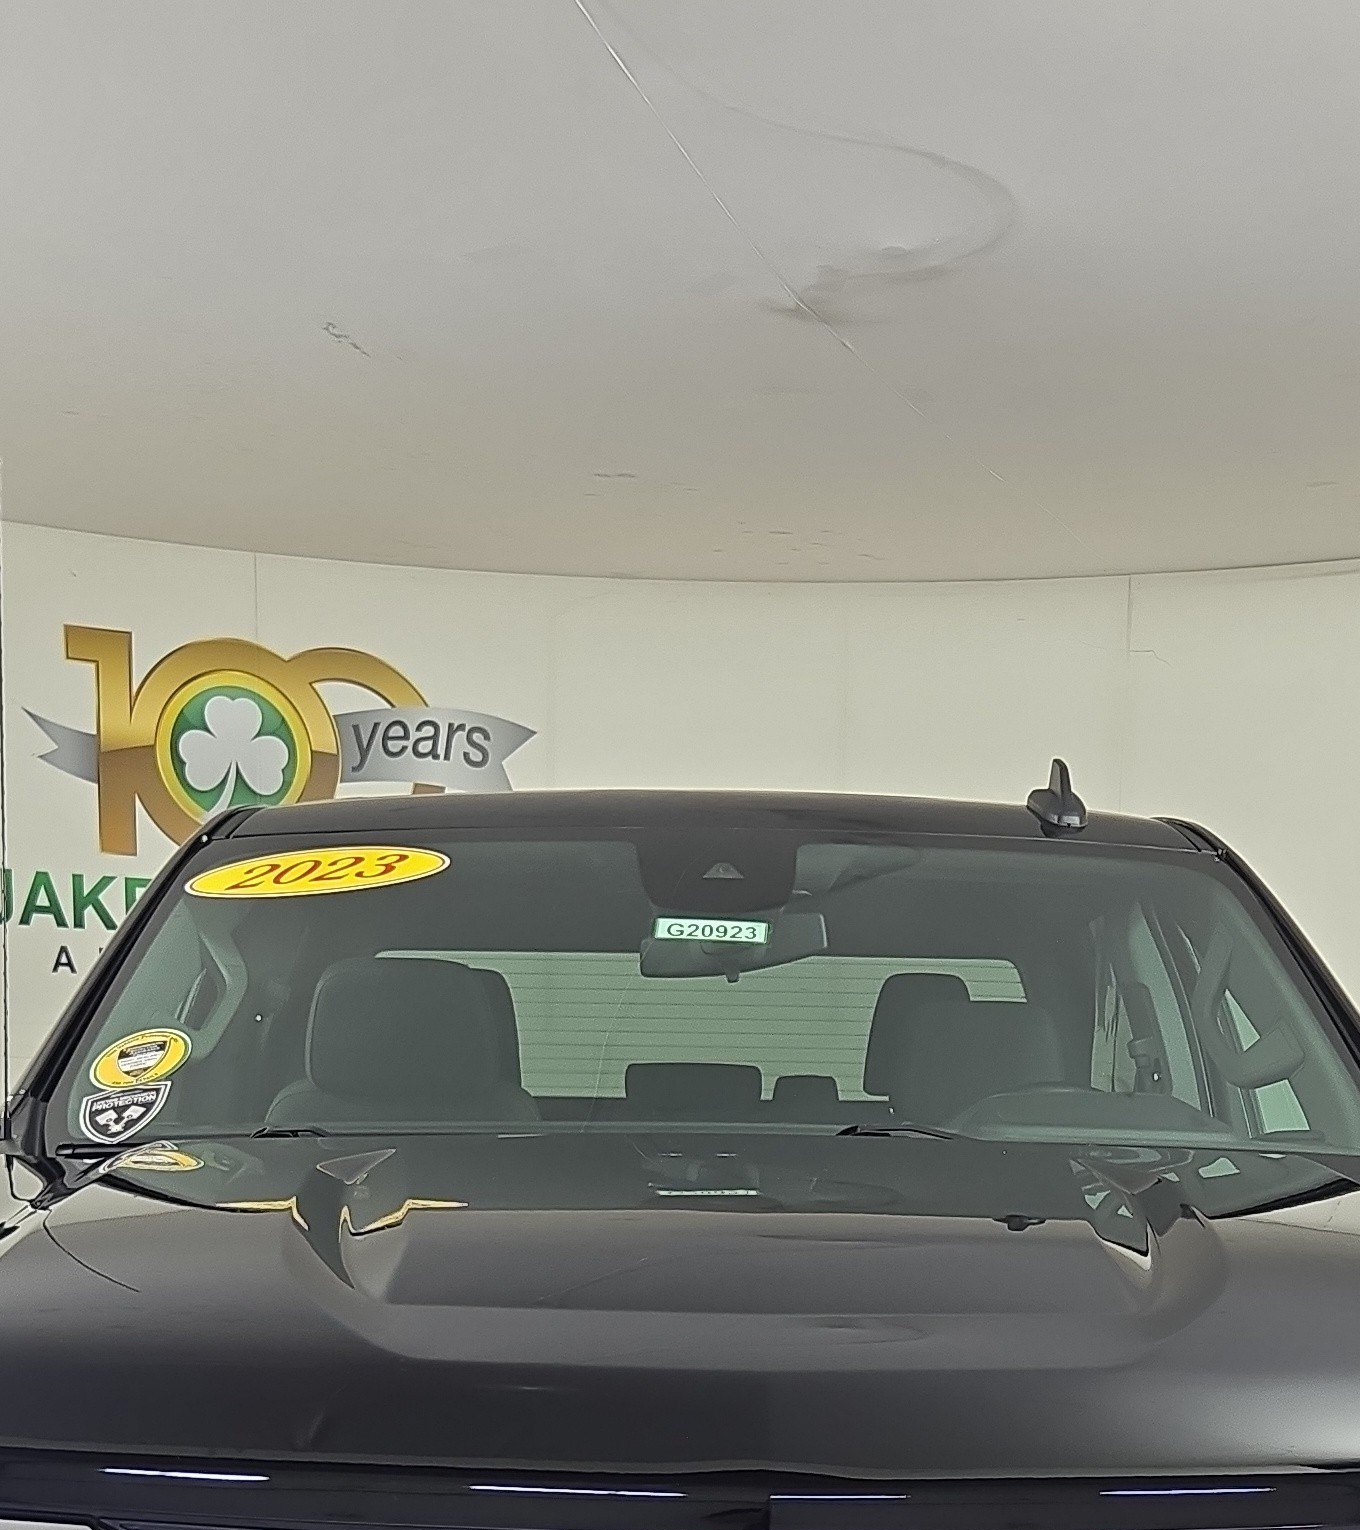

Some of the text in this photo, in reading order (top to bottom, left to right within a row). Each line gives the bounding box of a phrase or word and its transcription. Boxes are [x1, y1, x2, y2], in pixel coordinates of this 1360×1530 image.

[351, 718, 493, 772] years
[223, 853, 410, 891] 2023
[667, 923, 757, 940] G20923
